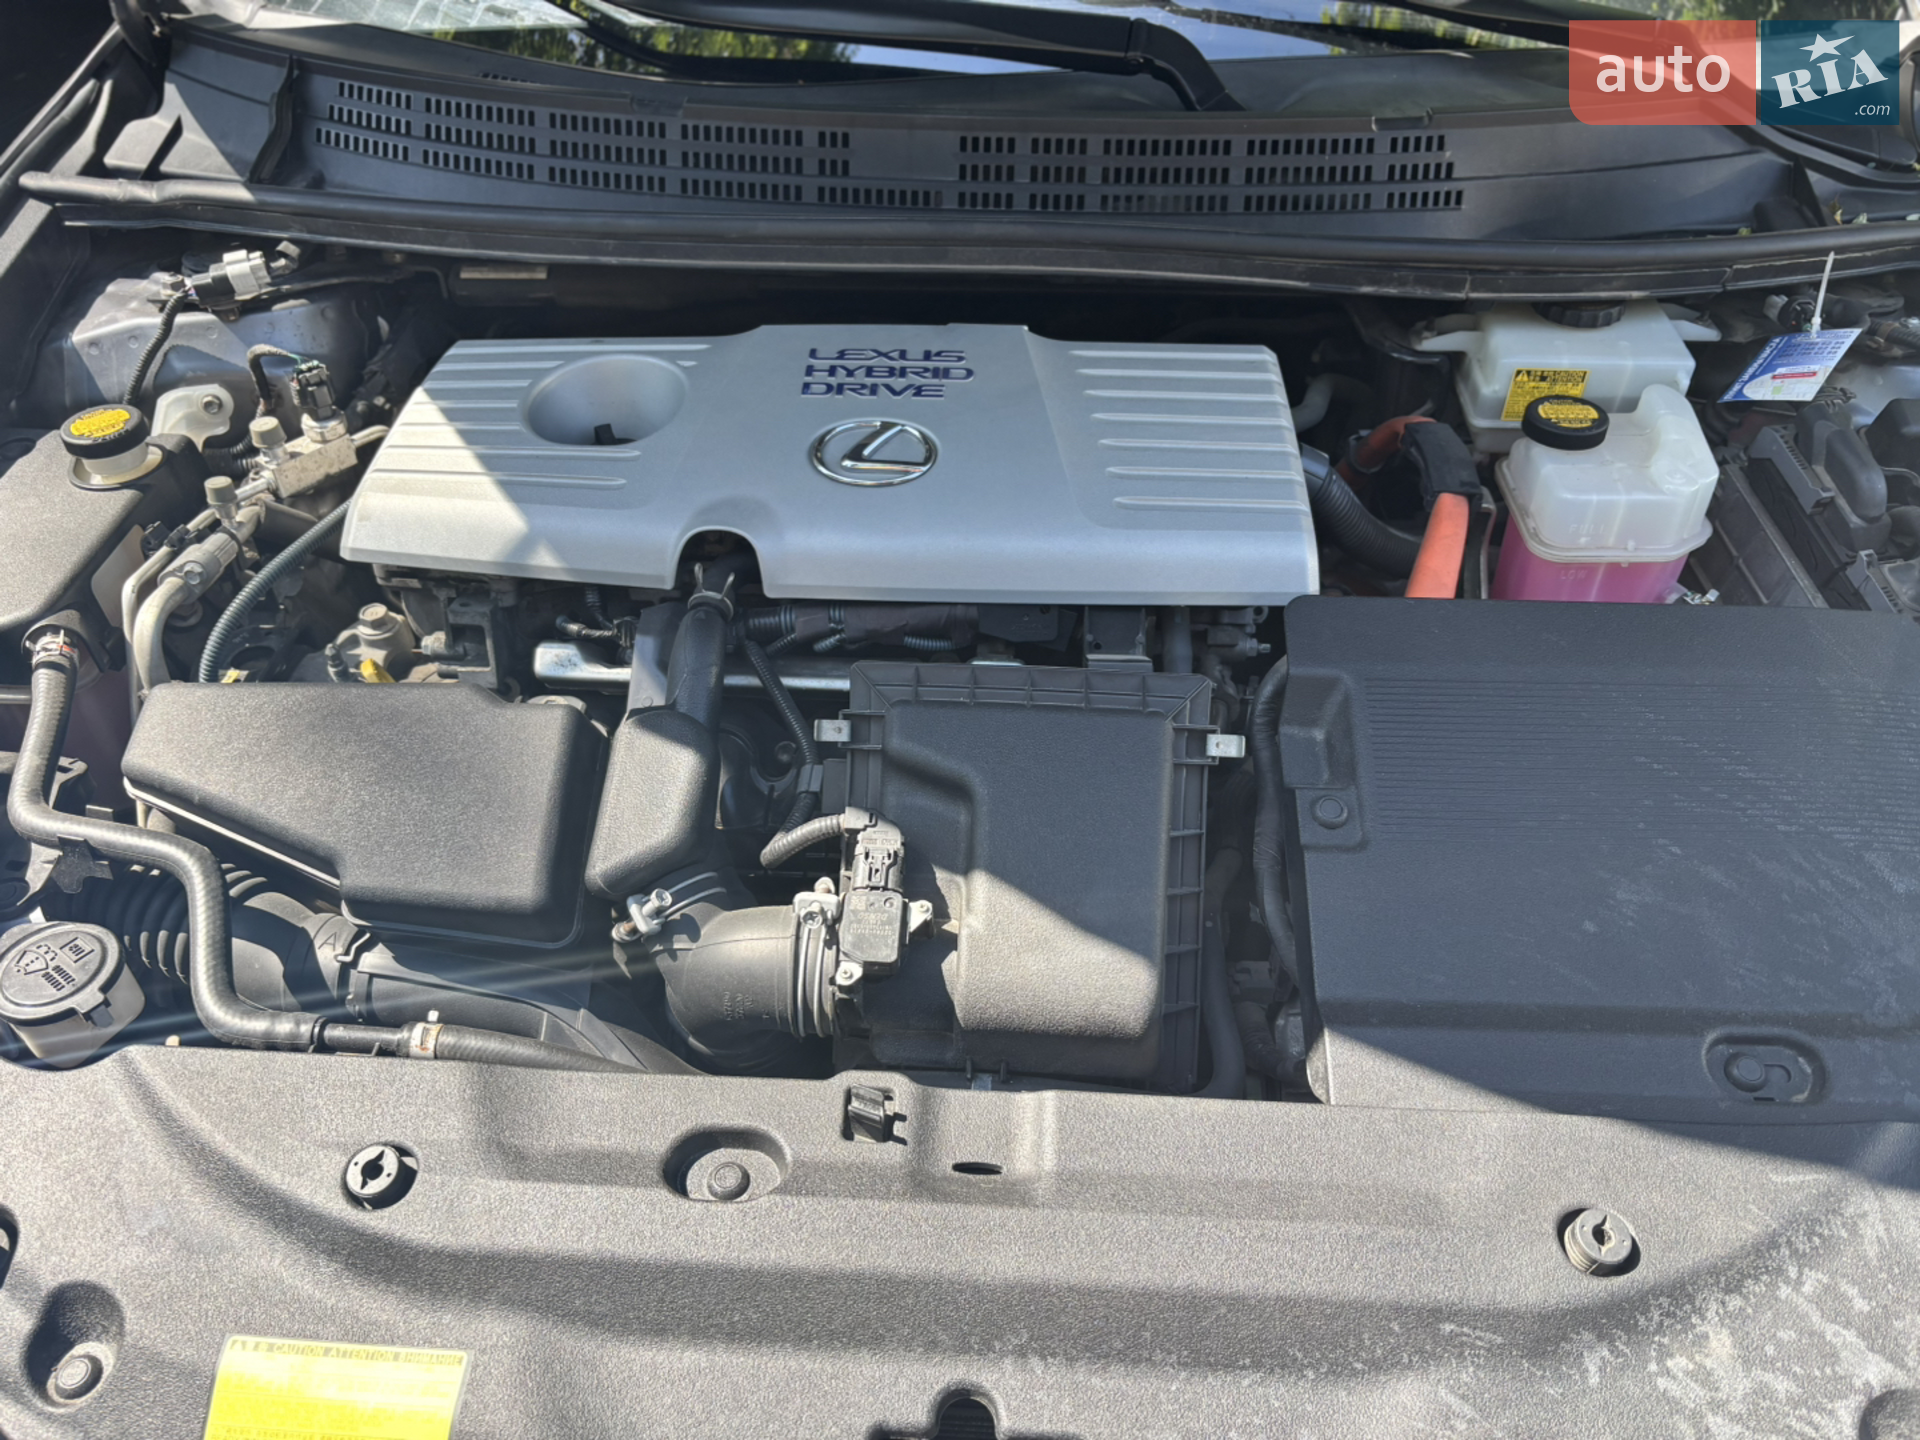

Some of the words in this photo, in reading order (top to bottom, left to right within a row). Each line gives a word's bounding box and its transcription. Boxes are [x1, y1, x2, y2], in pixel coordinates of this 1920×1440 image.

[808, 348, 967, 364] LEXUS
[804, 365, 975, 381] HYBRID
[801, 382, 947, 399] DRIVE
[1560, 569, 1589, 580] LOW
[317, 931, 338, 952] A
[274, 1342, 325, 1357] CAUTION
[328, 1346, 394, 1362] ATTENTION
